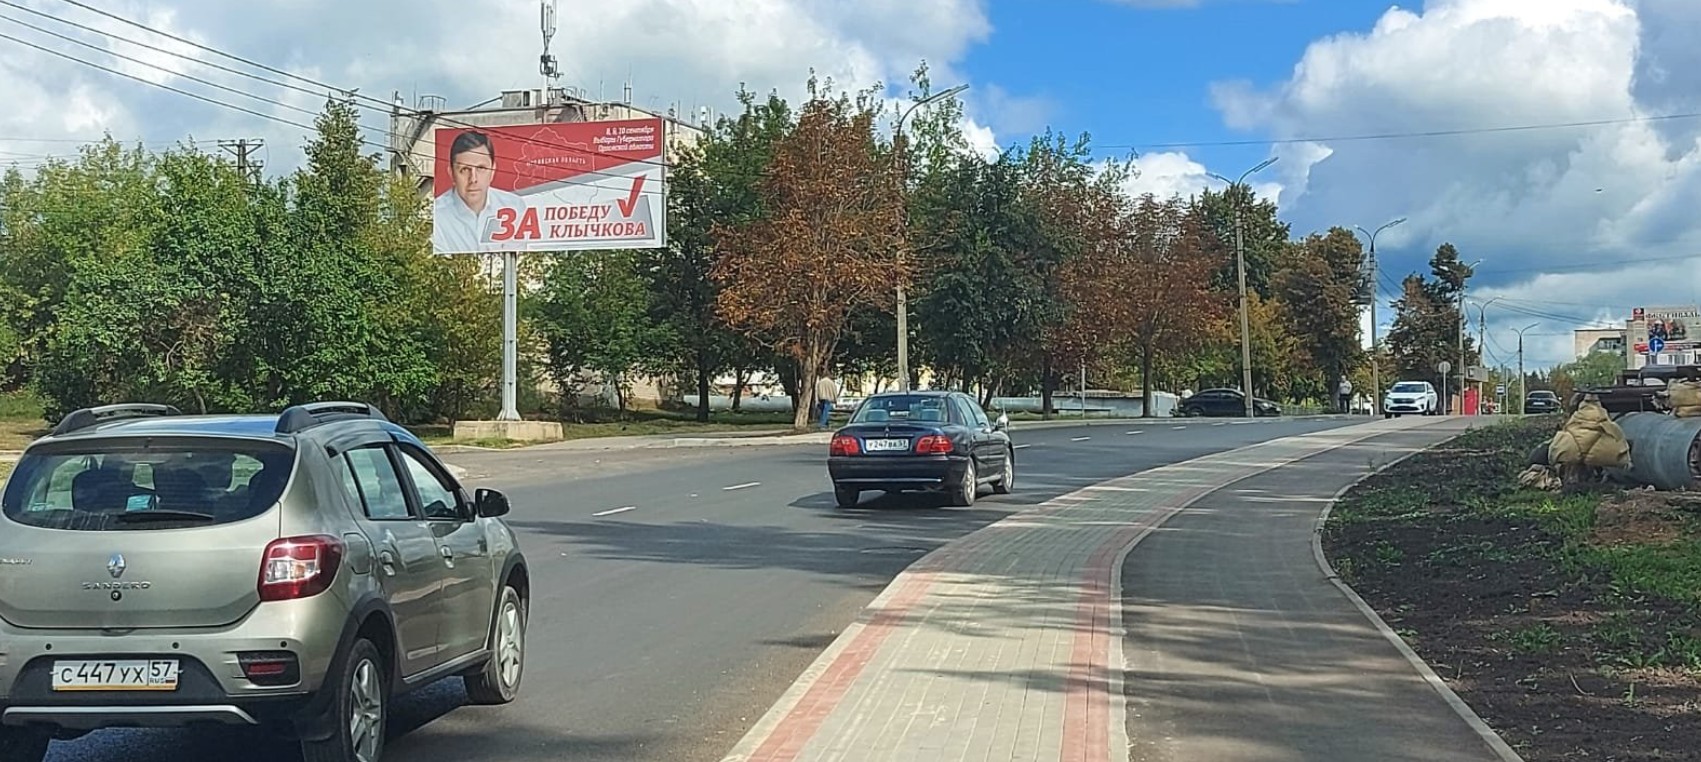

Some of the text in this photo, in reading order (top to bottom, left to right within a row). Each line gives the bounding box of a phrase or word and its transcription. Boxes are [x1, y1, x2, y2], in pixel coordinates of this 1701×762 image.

[544, 205, 611, 222] ПОБЕДУ
[491, 207, 542, 240] ЗА
[549, 222, 645, 238] КЛЫЧКОВА
[82, 581, 151, 590] SANDERO
[151, 661, 173, 677] 57
